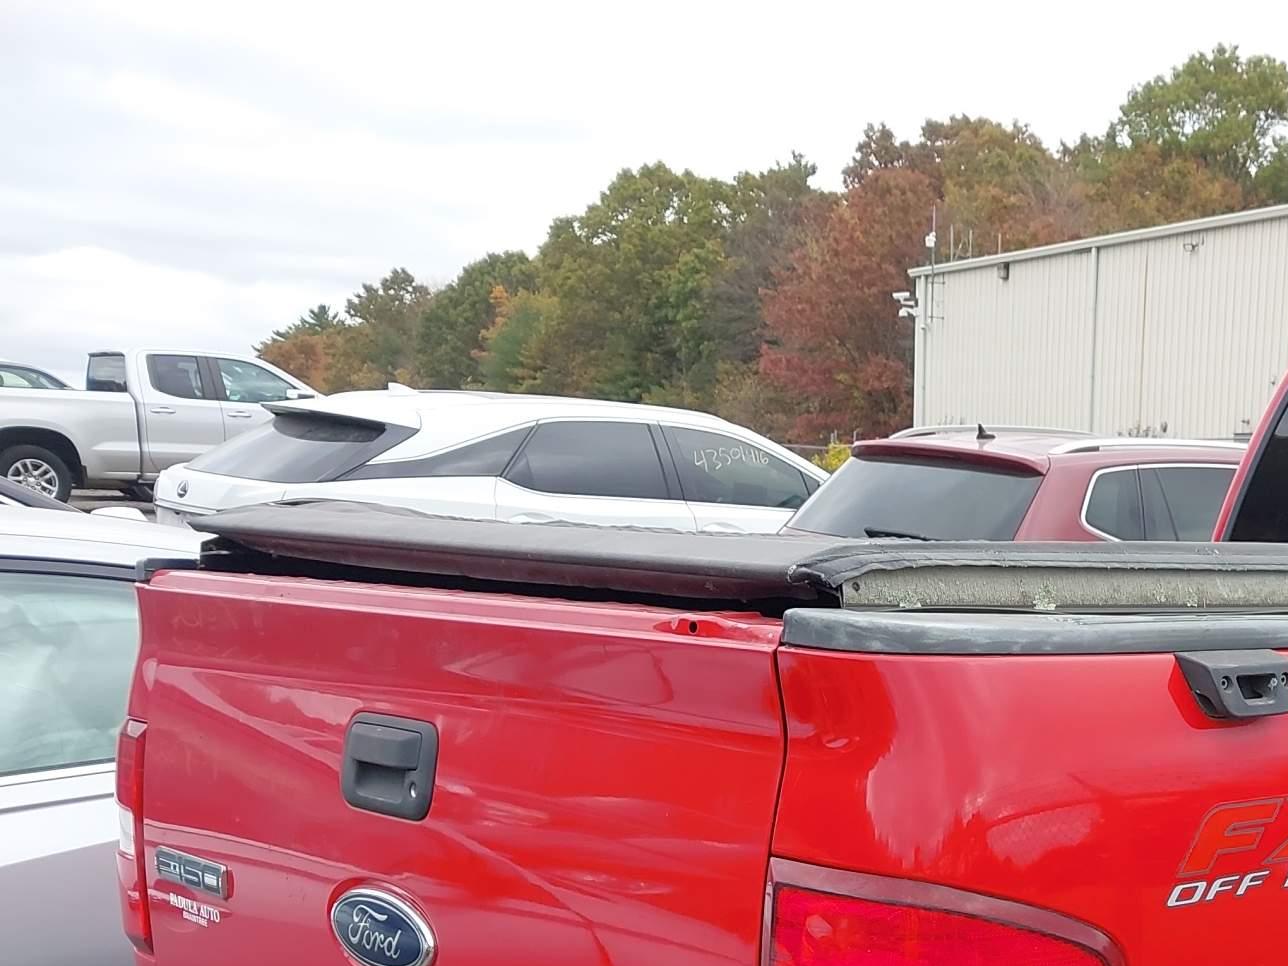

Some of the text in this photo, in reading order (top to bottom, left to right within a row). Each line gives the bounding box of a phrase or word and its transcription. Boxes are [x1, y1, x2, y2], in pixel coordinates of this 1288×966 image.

[169, 892, 220, 923] PADULA AUTO
[1166, 869, 1271, 909] OFF
[347, 903, 403, 960] Ford
